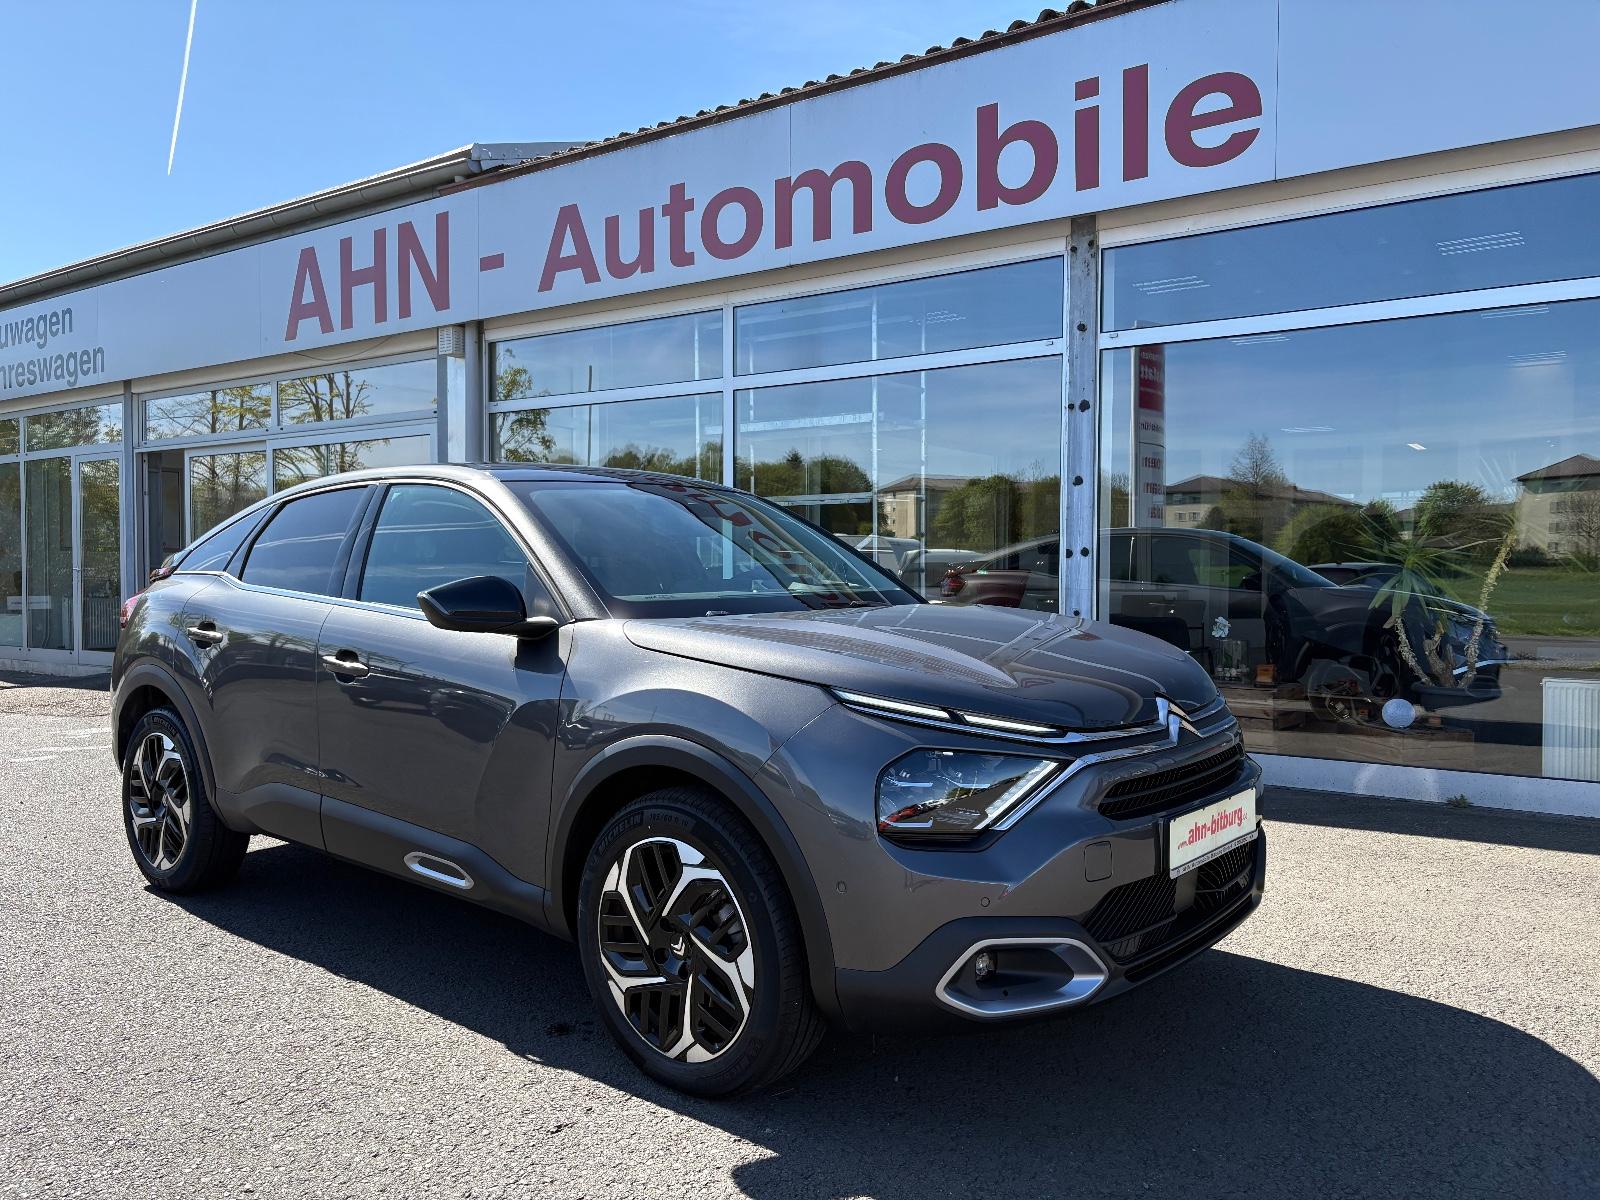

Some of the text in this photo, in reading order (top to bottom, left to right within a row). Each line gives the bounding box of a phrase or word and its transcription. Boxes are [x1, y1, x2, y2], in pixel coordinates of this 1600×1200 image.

[284, 210, 450, 342] AHN
[537, 63, 1263, 293] Automobile
[0, 307, 73, 349] uwagen
[597, 812, 643, 857] MICHELIN
